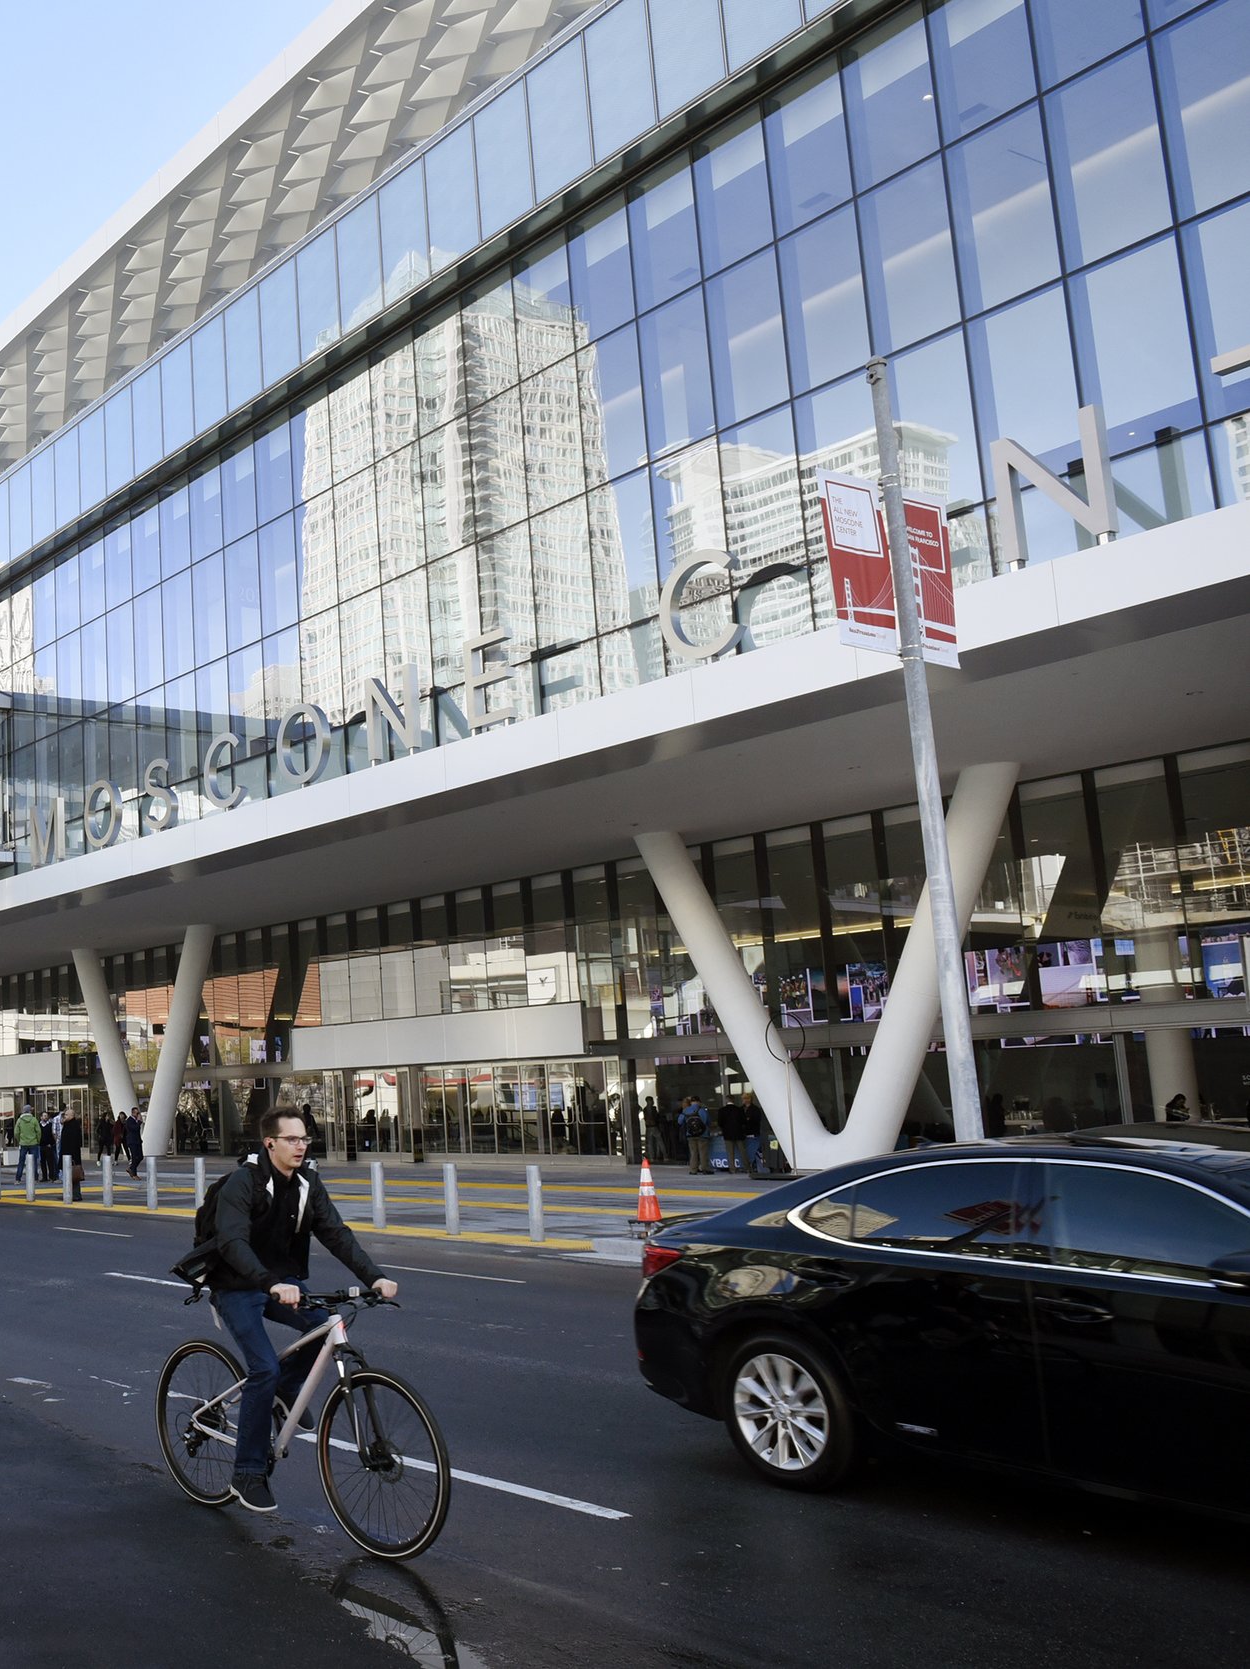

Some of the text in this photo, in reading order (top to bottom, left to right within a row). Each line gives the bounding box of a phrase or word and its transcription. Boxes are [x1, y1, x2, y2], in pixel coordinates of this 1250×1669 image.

[831, 495, 844, 505] THE
[844, 508, 859, 518] NEW
[836, 525, 858, 537] CENTER
[29, 628, 518, 867] MOSCONE
